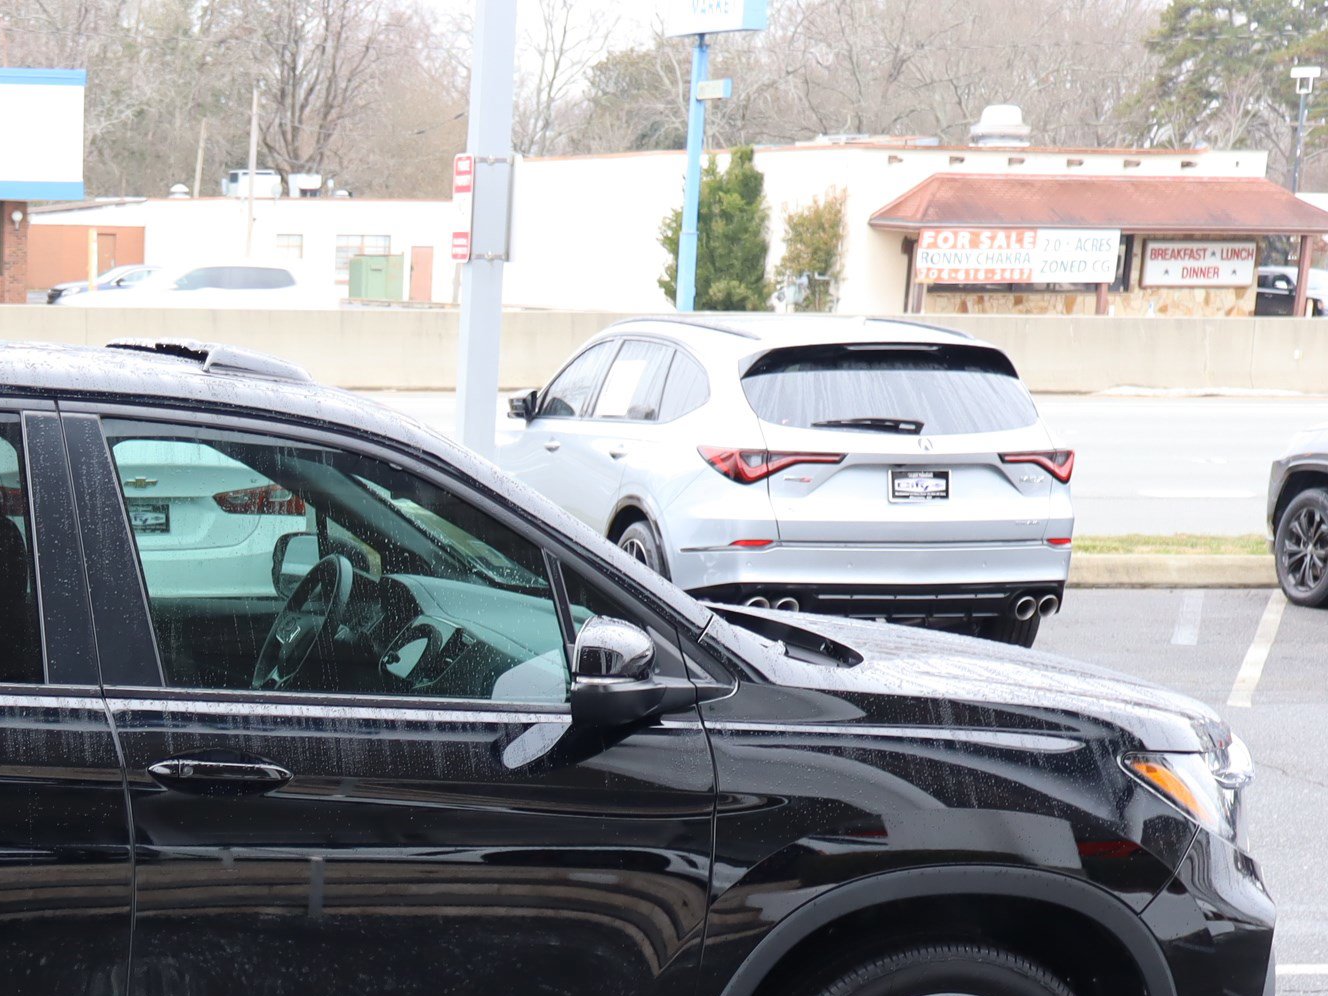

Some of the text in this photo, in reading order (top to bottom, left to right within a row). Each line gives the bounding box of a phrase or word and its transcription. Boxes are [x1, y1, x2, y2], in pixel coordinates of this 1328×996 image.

[921, 231, 1036, 249] FOR SALE
[1074, 237, 1113, 252] ACRES
[920, 252, 1031, 265] RONNY CHAKRA
[1149, 247, 1255, 260] BREAKFAST LUNCH
[1039, 259, 1088, 274] ZONED
[1181, 266, 1220, 279] DINNER
